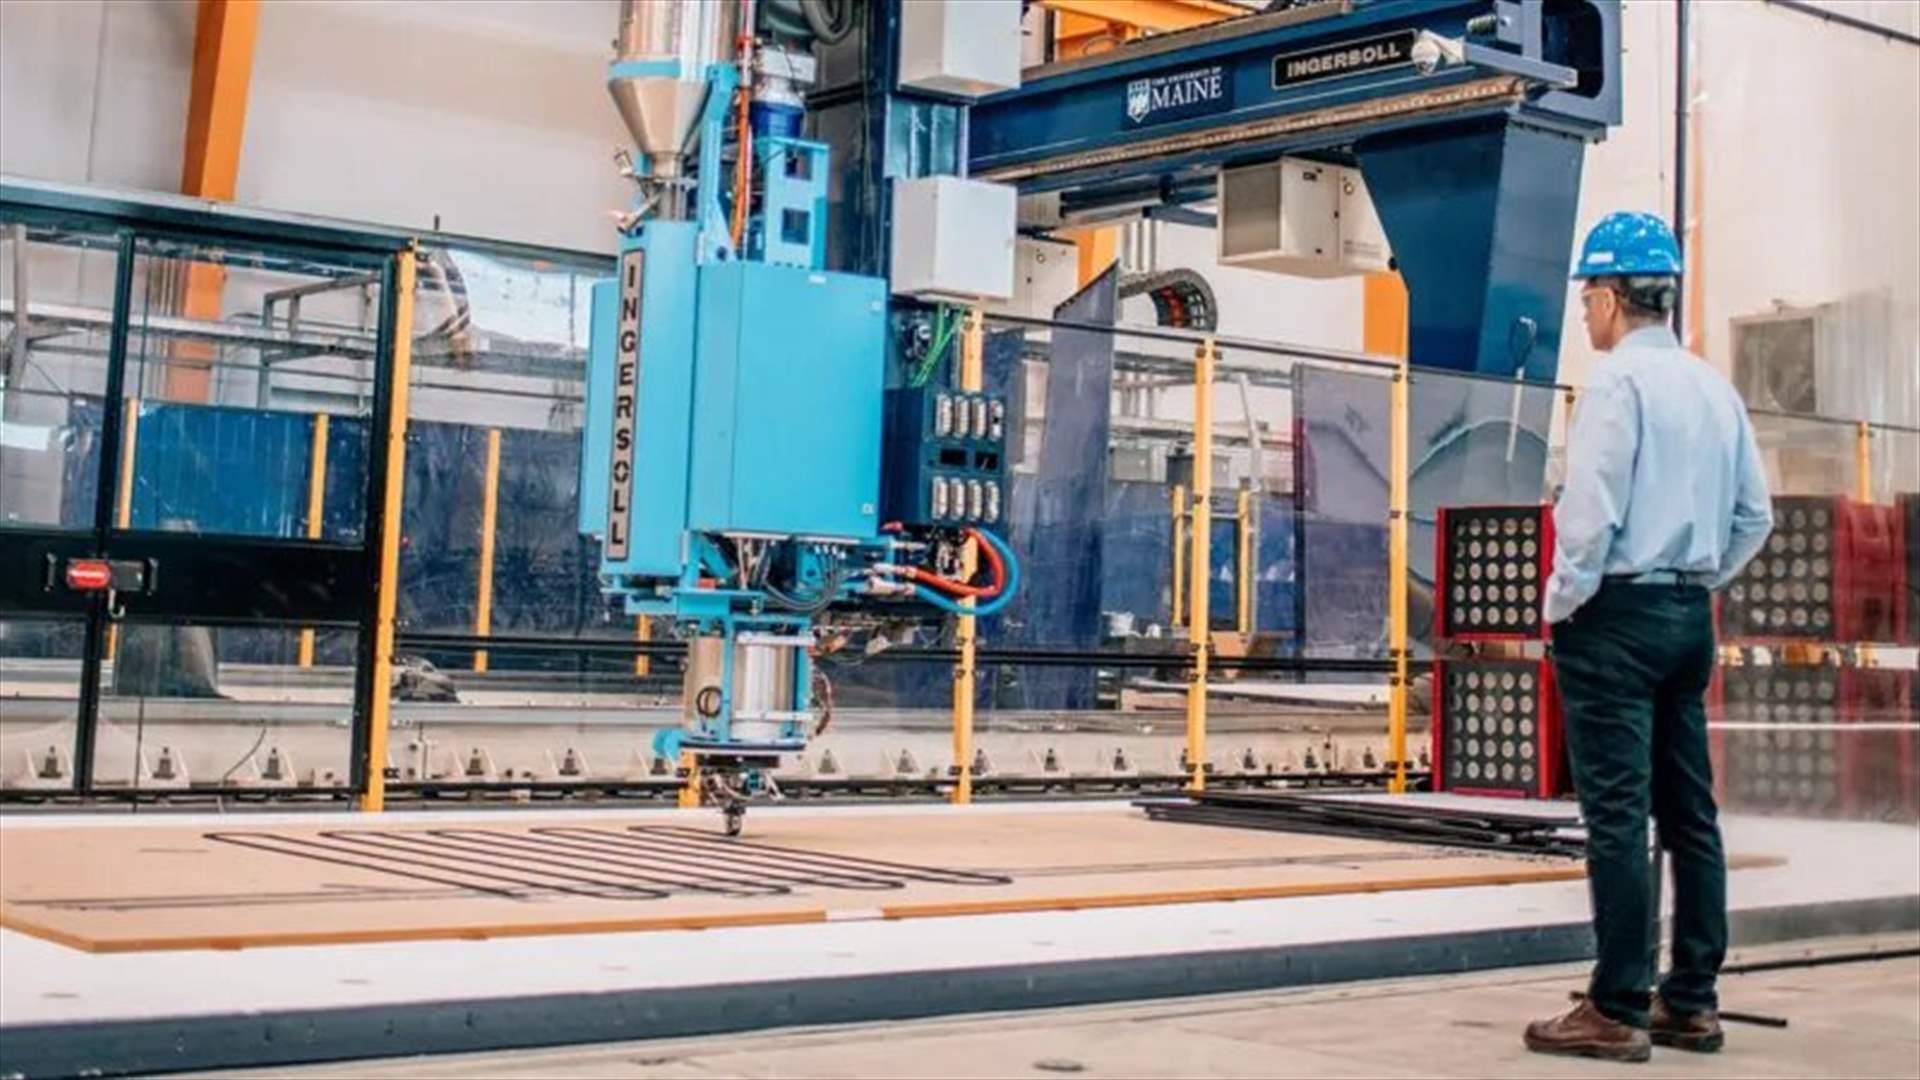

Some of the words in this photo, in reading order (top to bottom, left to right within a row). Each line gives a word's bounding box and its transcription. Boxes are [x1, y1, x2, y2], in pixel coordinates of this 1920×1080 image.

[1286, 42, 1401, 77] INGERSOLL
[1152, 75, 1222, 110] MAINE
[611, 264, 637, 544] INGERSOLL
